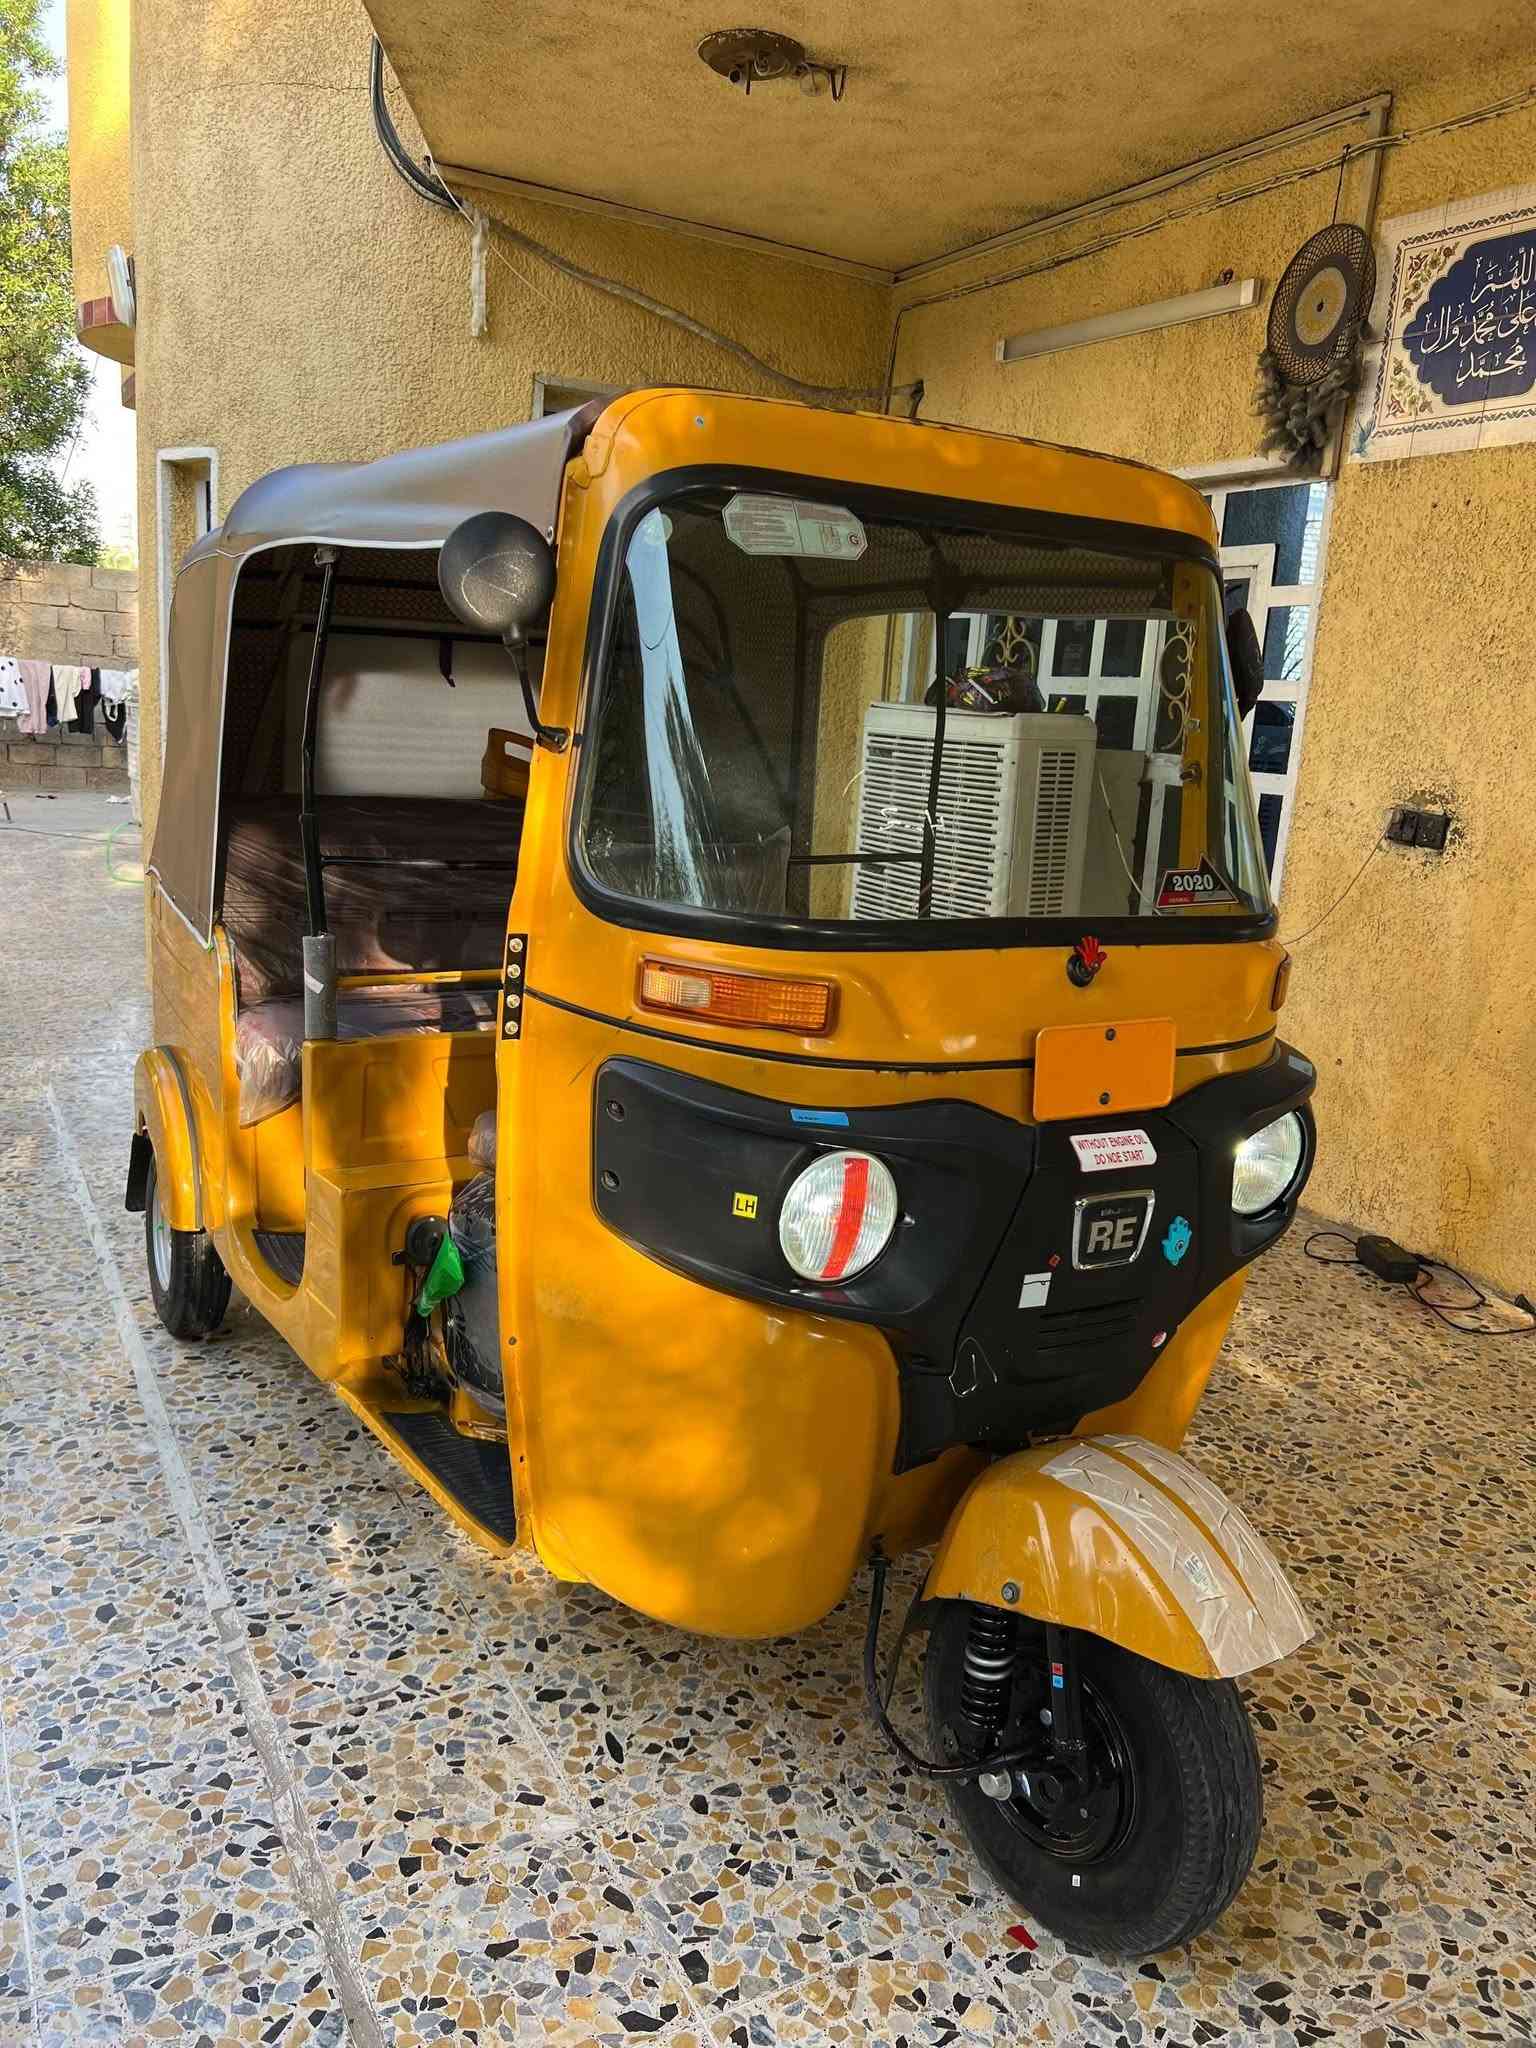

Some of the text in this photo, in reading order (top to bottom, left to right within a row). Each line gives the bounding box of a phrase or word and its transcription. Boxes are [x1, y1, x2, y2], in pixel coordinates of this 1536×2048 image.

[1173, 874, 1214, 891] 2020
[1077, 1137, 1106, 1151] WITHOUT
[1107, 1136, 1136, 1147] ENGINE
[1094, 1153, 1106, 1165] DO
[1122, 1149, 1145, 1162] START
[735, 1197, 756, 1213] LH
[1086, 1216, 1137, 1253] RE
